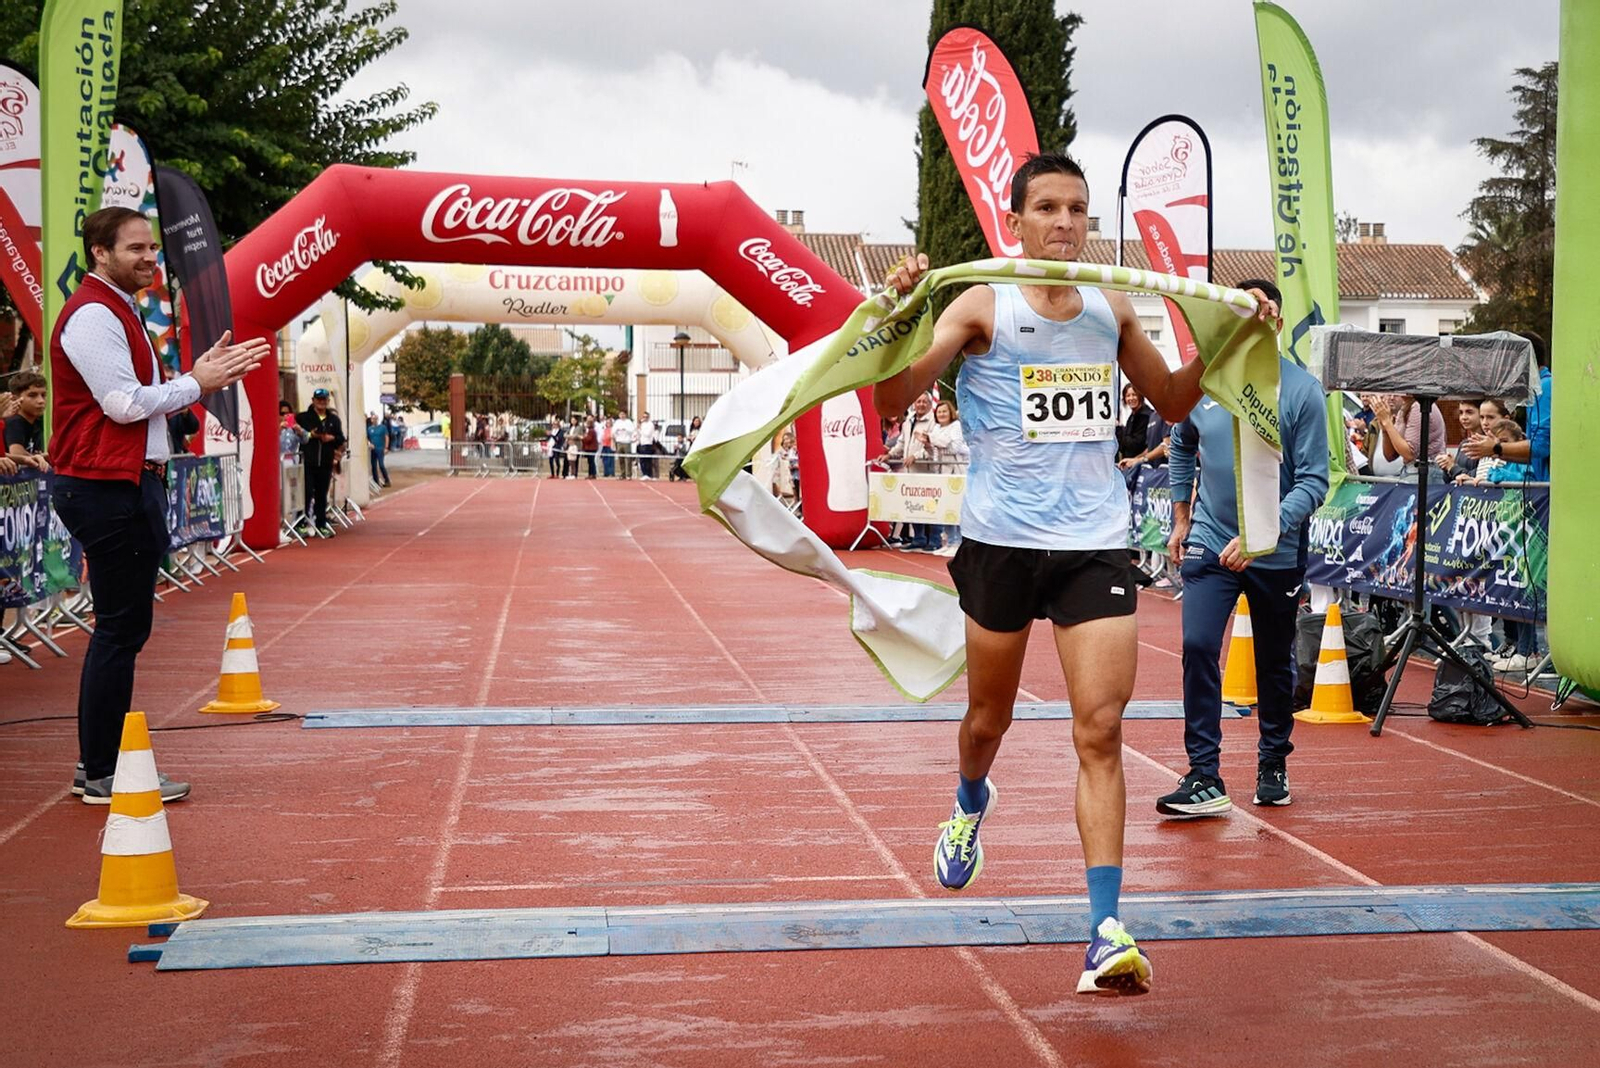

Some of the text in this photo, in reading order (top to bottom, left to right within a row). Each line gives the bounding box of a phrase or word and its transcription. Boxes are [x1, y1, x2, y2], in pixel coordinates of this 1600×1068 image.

[420, 183, 627, 248] Coca-Cola
[256, 213, 341, 299] Coca-Cola
[488, 268, 626, 295] Cruzcampo
[737, 236, 827, 309] Coca-Cola
[501, 297, 570, 319] Radler
[1036, 369, 1053, 383] 38
[1053, 372, 1102, 384] FONDO
[1026, 391, 1112, 422] 3013
[900, 483, 942, 499] Cruzcampo
[1308, 515, 1344, 547] ONDO
